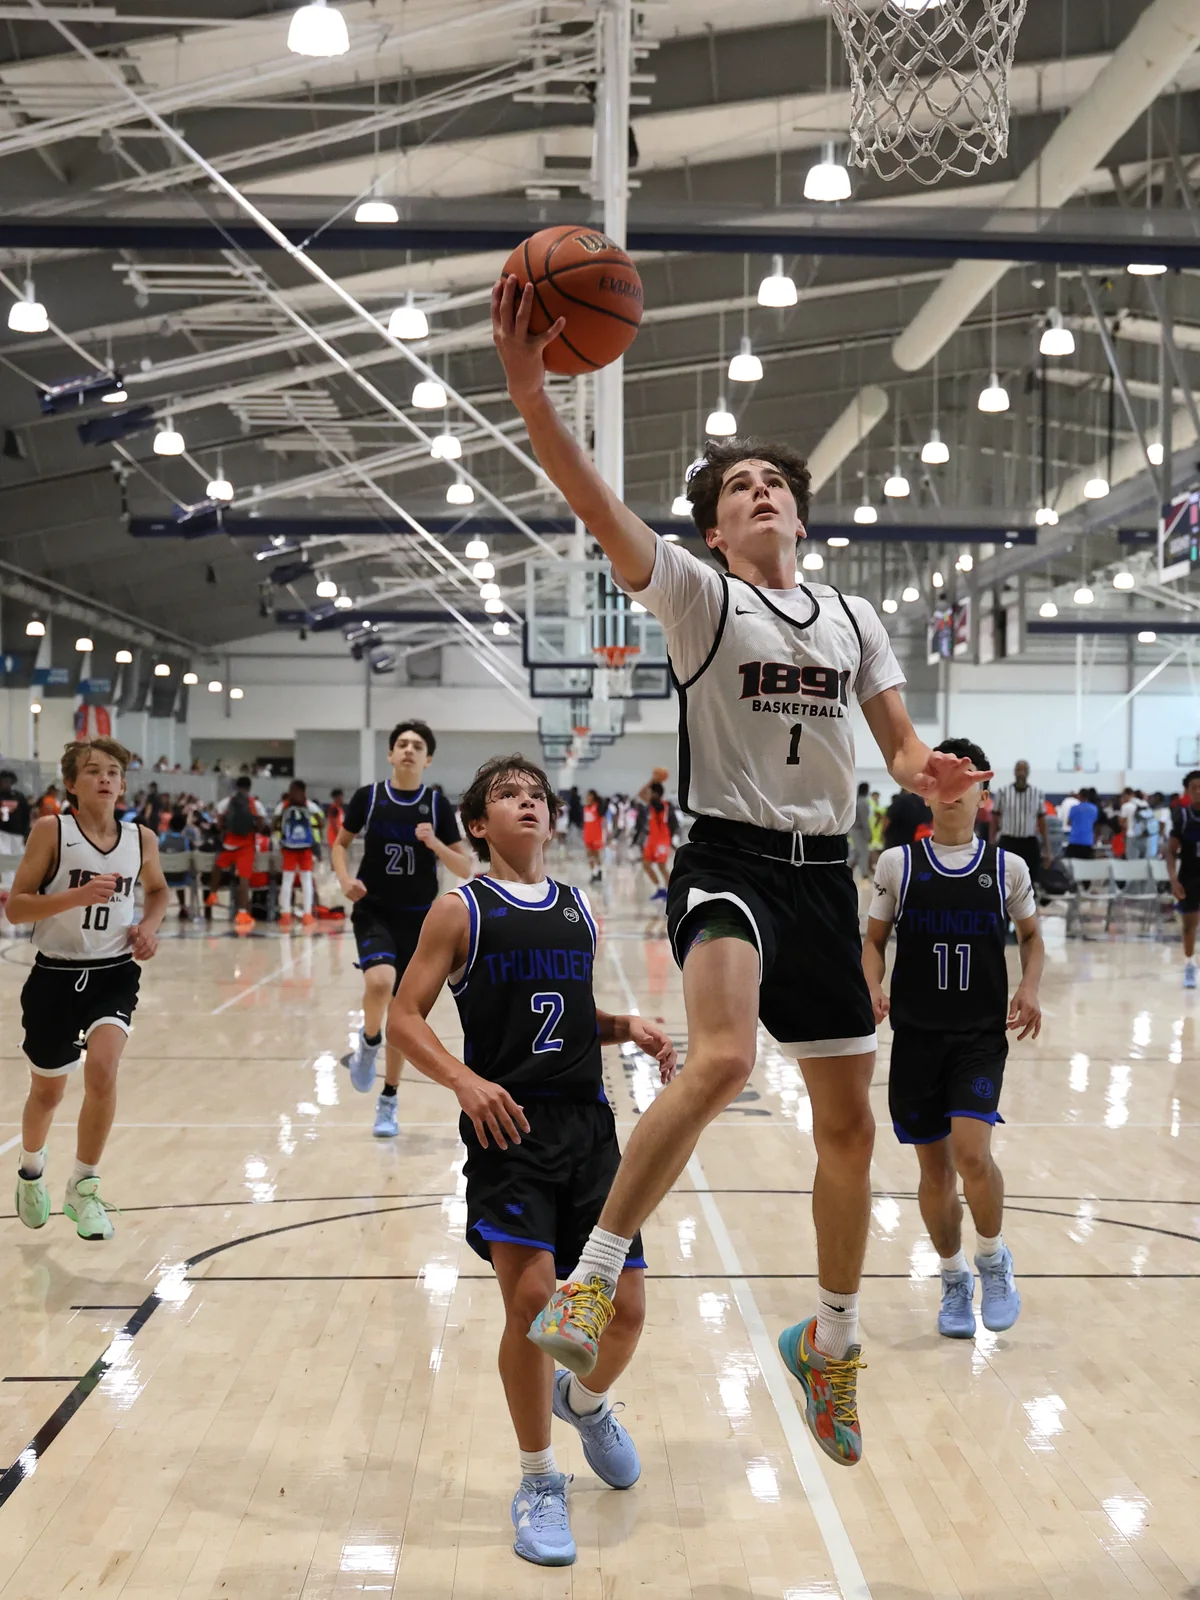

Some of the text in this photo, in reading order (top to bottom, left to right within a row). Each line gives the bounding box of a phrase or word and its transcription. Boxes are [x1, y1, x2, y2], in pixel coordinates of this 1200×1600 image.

[752, 700, 843, 718] BASKETBALL
[786, 723, 802, 765] 1
[385, 843, 415, 875] 21
[82, 905, 109, 931] 10
[484, 949, 593, 984] THUNDER
[933, 943, 971, 991] 11
[531, 992, 564, 1054] 2
